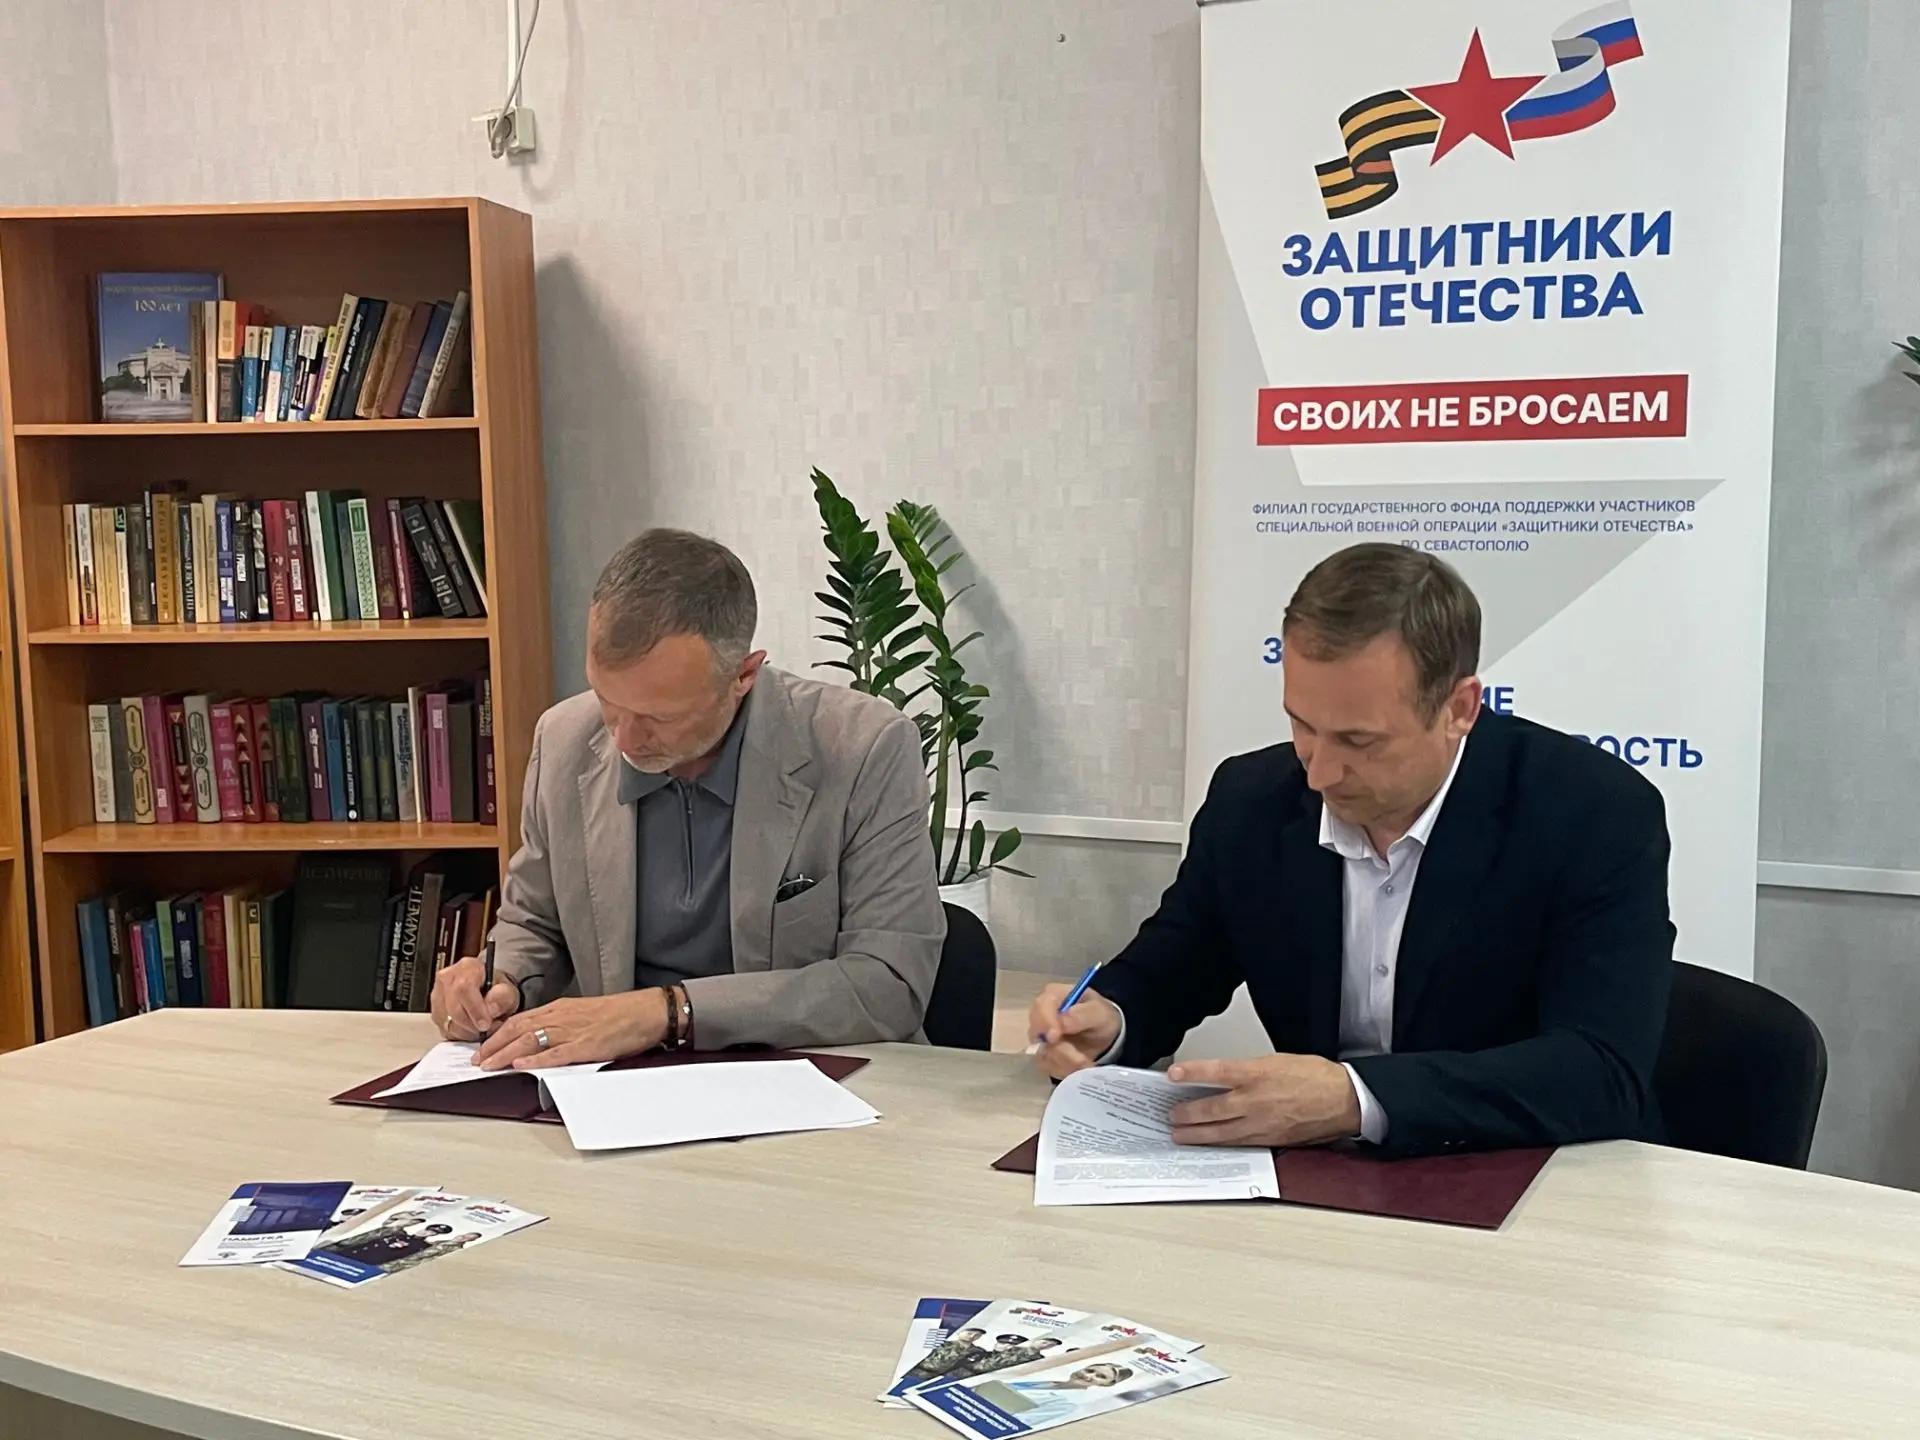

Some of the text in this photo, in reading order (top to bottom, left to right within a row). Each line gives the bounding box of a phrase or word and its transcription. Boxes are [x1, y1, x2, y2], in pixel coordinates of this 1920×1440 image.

[1282, 210, 1672, 277] ЗАЩИТНИКИ
[1300, 271, 1644, 330] ОТЕЧЕСТВА
[1273, 391, 1669, 432] СВОИХ НЕ БРОСАЕМ
[1252, 499, 1696, 515] ФИЛИАЛ ГОСУДАРСТВЕННОГО ФОНДА ПОДДЕРЖКИ УЧАСТНИКОВ
[1256, 518, 1694, 533] СПЕЦИАЛЬНОЙ ВОЕННОЙ ОПЕРАЦИИ «ЗАЩИТНИКИ ОТЕЧЕСТВА»
[1424, 539, 1529, 551] СЕВАСТОПОЛЮ
[402, 888, 423, 957] СКАРЛЕТТ
